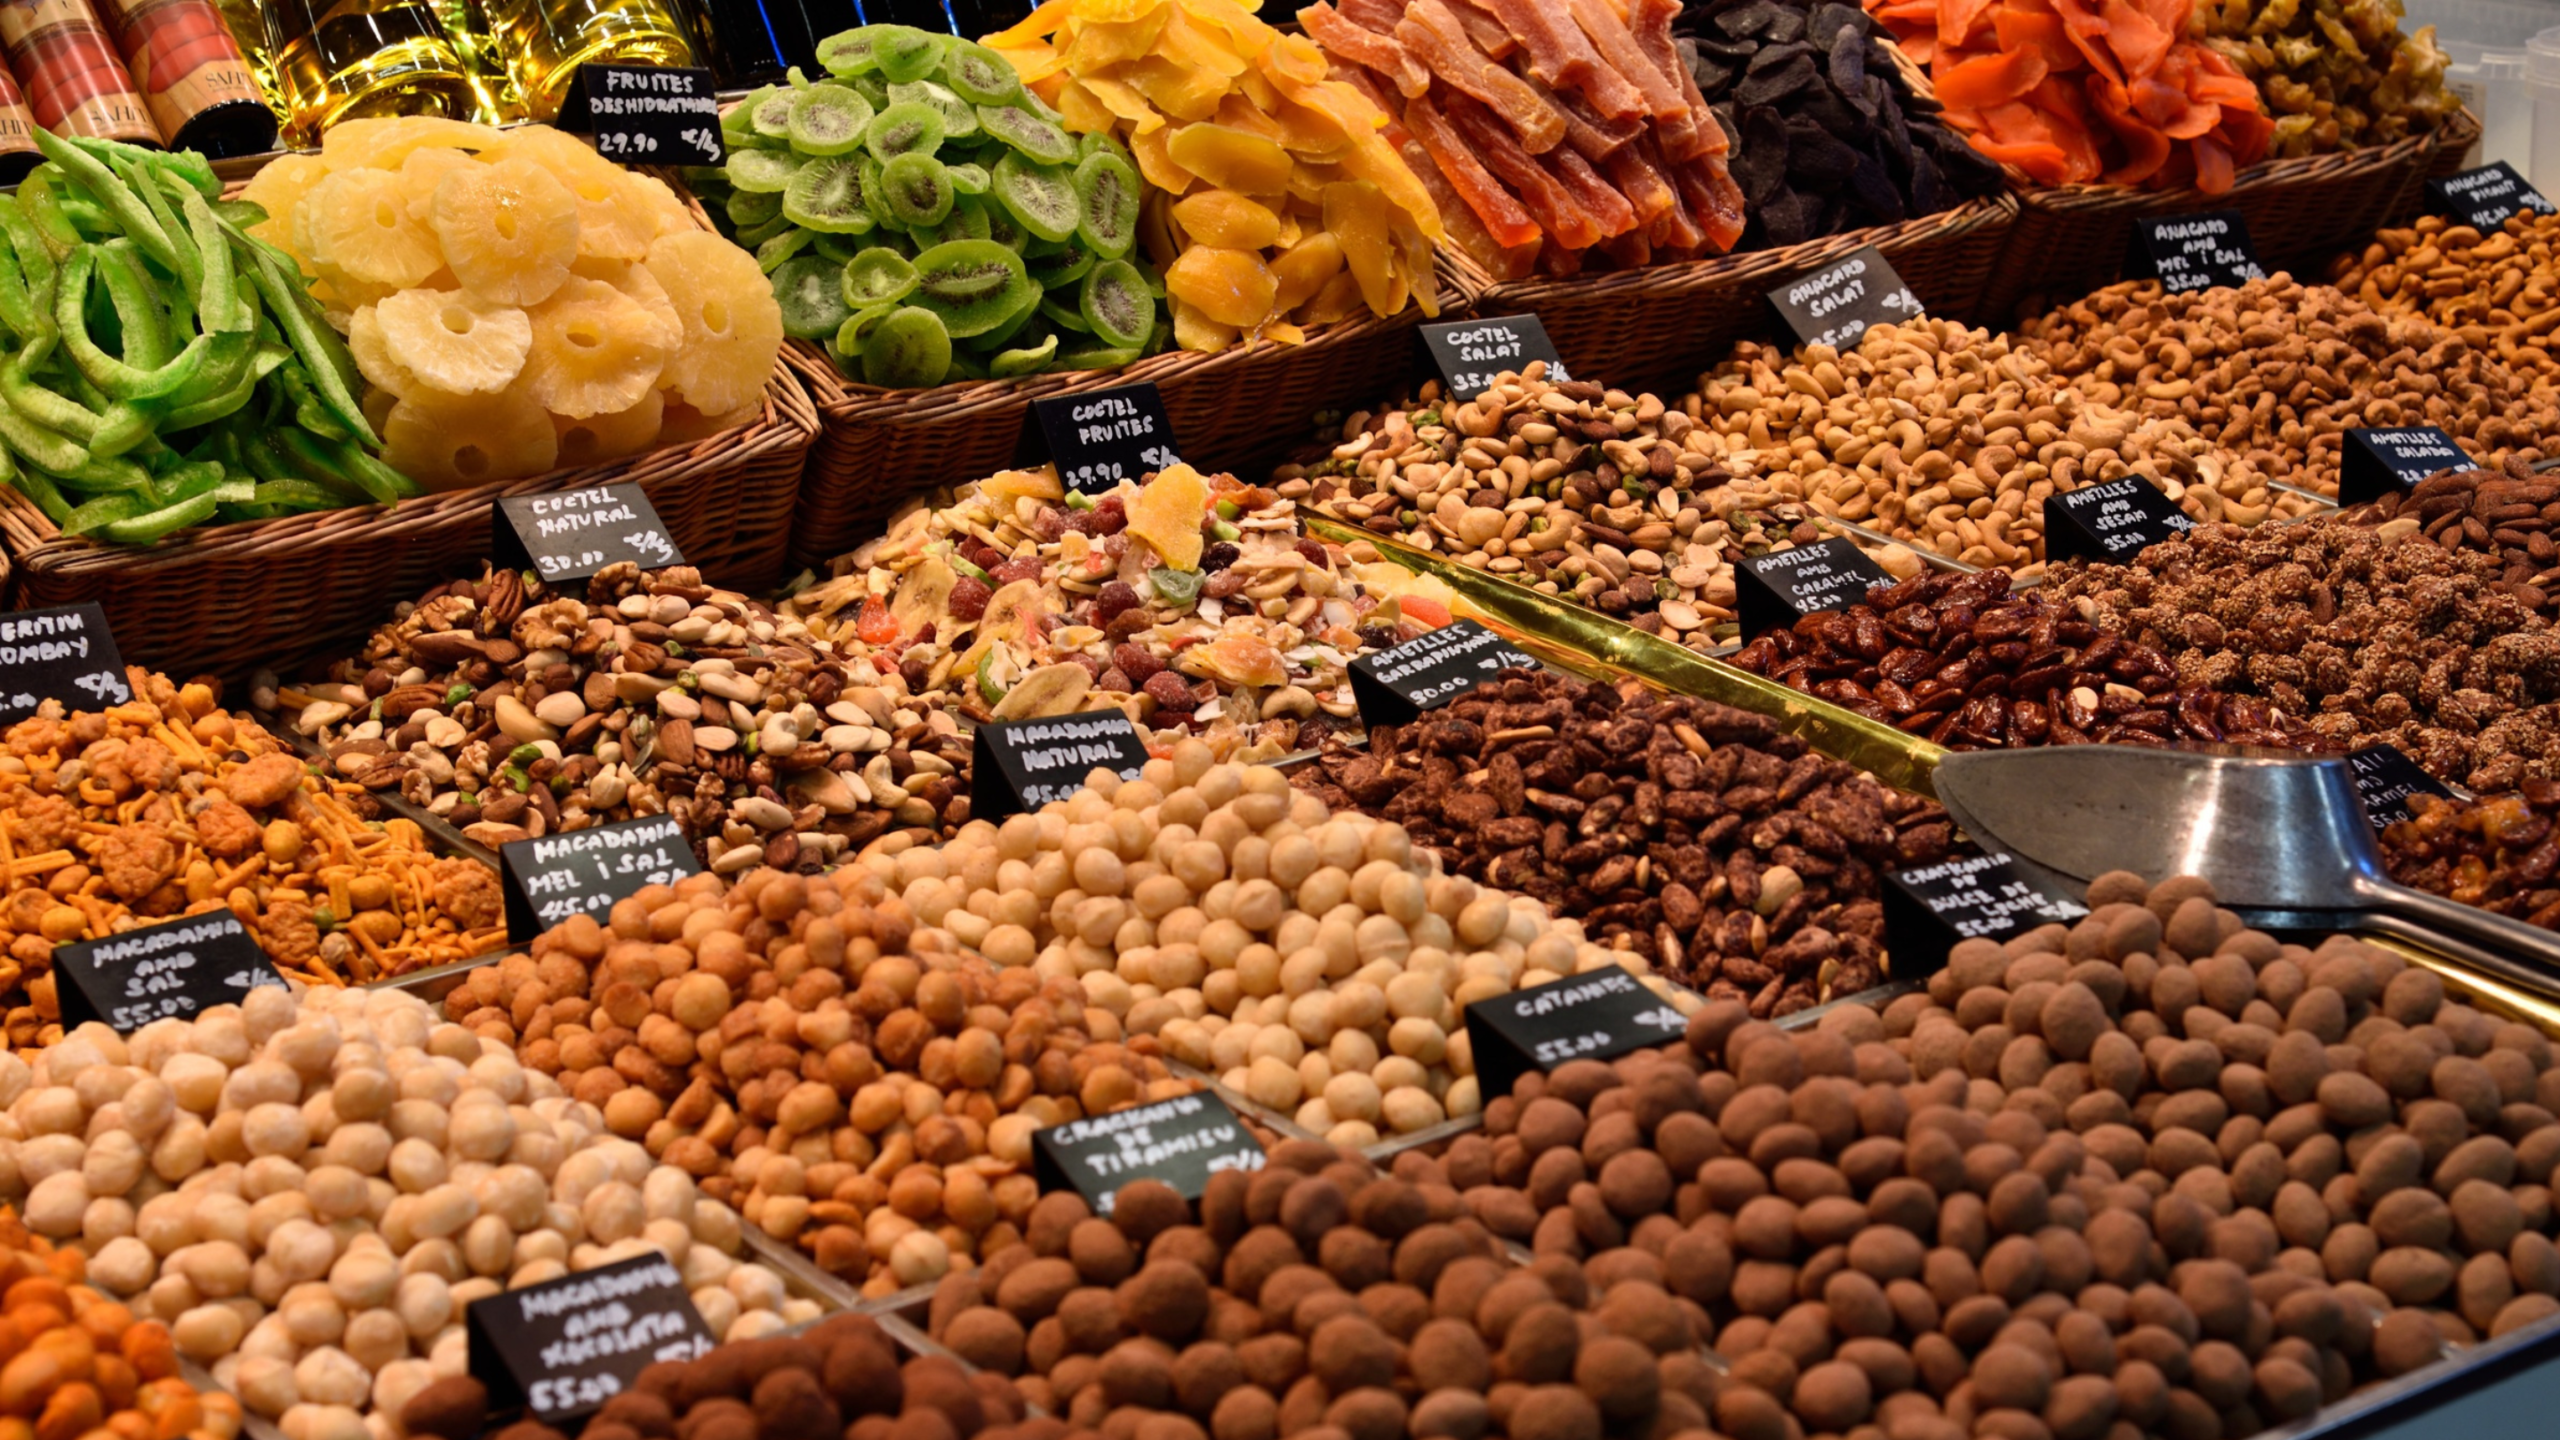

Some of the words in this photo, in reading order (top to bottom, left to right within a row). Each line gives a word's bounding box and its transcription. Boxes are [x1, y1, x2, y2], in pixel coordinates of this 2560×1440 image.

[606, 70, 693, 93] FRUITES
[600, 132, 658, 154] 29.90
[2445, 168, 2504, 196] ANACARD
[2155, 219, 2228, 241] ANACARD
[2183, 236, 2217, 254] AMB
[2156, 255, 2190, 274] MEL
[2215, 247, 2246, 265] SAL
[1789, 259, 1866, 306] ANACARD
[2165, 273, 2211, 292] 35.00
[1810, 279, 1865, 318] SALAT
[1447, 326, 1519, 346] COCTEL
[1460, 342, 1521, 362] SALAT
[1453, 372, 1496, 391] 35.0
[1072, 397, 1138, 422] COCTEL
[1078, 415, 1154, 445] FRUITES
[2370, 432, 2442, 446] AMETLLES
[1066, 462, 1122, 488] 29.90
[532, 487, 618, 514] COCTEL
[2066, 479, 2138, 509] AMETLLES
[2101, 499, 2131, 515] AMB
[537, 504, 637, 538] NATURAL
[2095, 509, 2148, 531] SESAM
[2104, 532, 2146, 552] 35.00
[1756, 543, 1831, 574] AMETLLES
[1797, 563, 1832, 578] AMB
[1791, 570, 1867, 596] CARAMEL
[1795, 594, 1842, 612] 45.00
[0, 636, 88, 665] OMBAY
[1371, 623, 1469, 668] AMETLLES
[1005, 718, 1133, 747] MACADAMIA
[1022, 740, 1124, 772] NATURAL
[533, 820, 681, 864] MACADAMIA
[527, 868, 582, 896] MEL
[615, 847, 674, 874] SAL
[1951, 874, 1978, 890] DE
[1928, 889, 1996, 913] DULCE
[2000, 881, 2030, 898] DE
[1979, 892, 2049, 917] LECHE
[92, 918, 243, 969] MACADAMIA
[134, 951, 197, 977] AMB
[125, 970, 185, 998] SAL
[112, 995, 197, 1031] 55.00
[1085, 1124, 1236, 1177] TIRAMISU
[1113, 1125, 1153, 1151] DE
[563, 1301, 632, 1340] AMB
